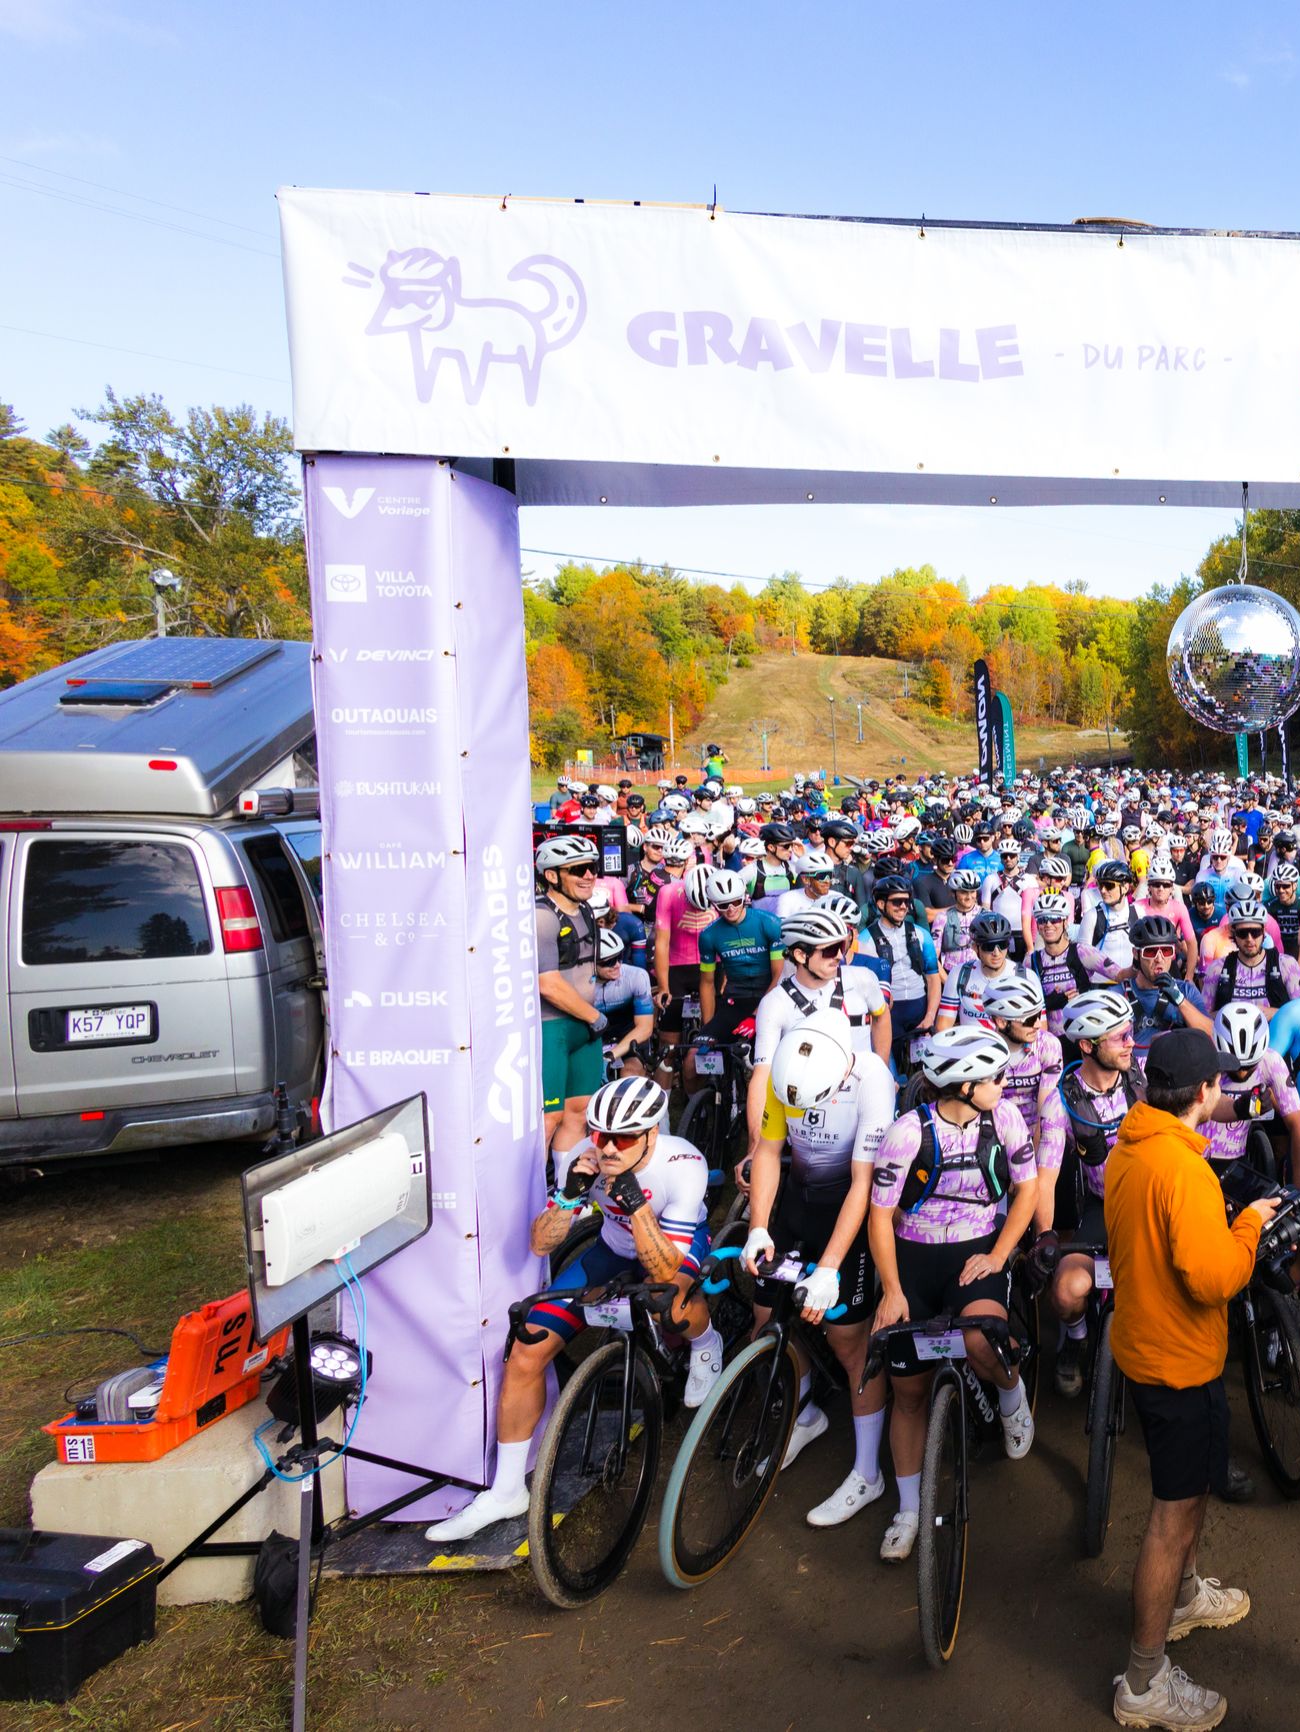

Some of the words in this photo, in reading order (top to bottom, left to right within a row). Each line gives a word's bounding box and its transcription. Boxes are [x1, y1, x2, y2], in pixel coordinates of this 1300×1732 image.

[626, 310, 1024, 383] GRAVELLE
[1081, 343, 1124, 370] DU
[1137, 344, 1207, 372] PARC
[377, 496, 421, 505] CENTRE
[377, 506, 432, 518] Vorlage
[375, 570, 416, 583] VILLA
[375, 585, 433, 598] TOYOTA
[356, 649, 435, 662] DEVINCI
[331, 708, 438, 724] OUTAOUAIS
[356, 781, 442, 796] BUSHTUKAH
[338, 851, 446, 870] WILLIAM
[515, 862, 536, 961] PARC
[340, 912, 448, 928] CHELSEA
[374, 933, 389, 946] &
[482, 843, 514, 1028] NOMADES
[380, 990, 449, 1008] DUSK
[523, 971, 537, 1020] DU
[72, 1016, 103, 1033] K57
[116, 1013, 145, 1029] YQP
[131, 1049, 220, 1065] CHEVROLET
[346, 1050, 365, 1066] LE
[369, 1048, 452, 1066] BRAQUET
